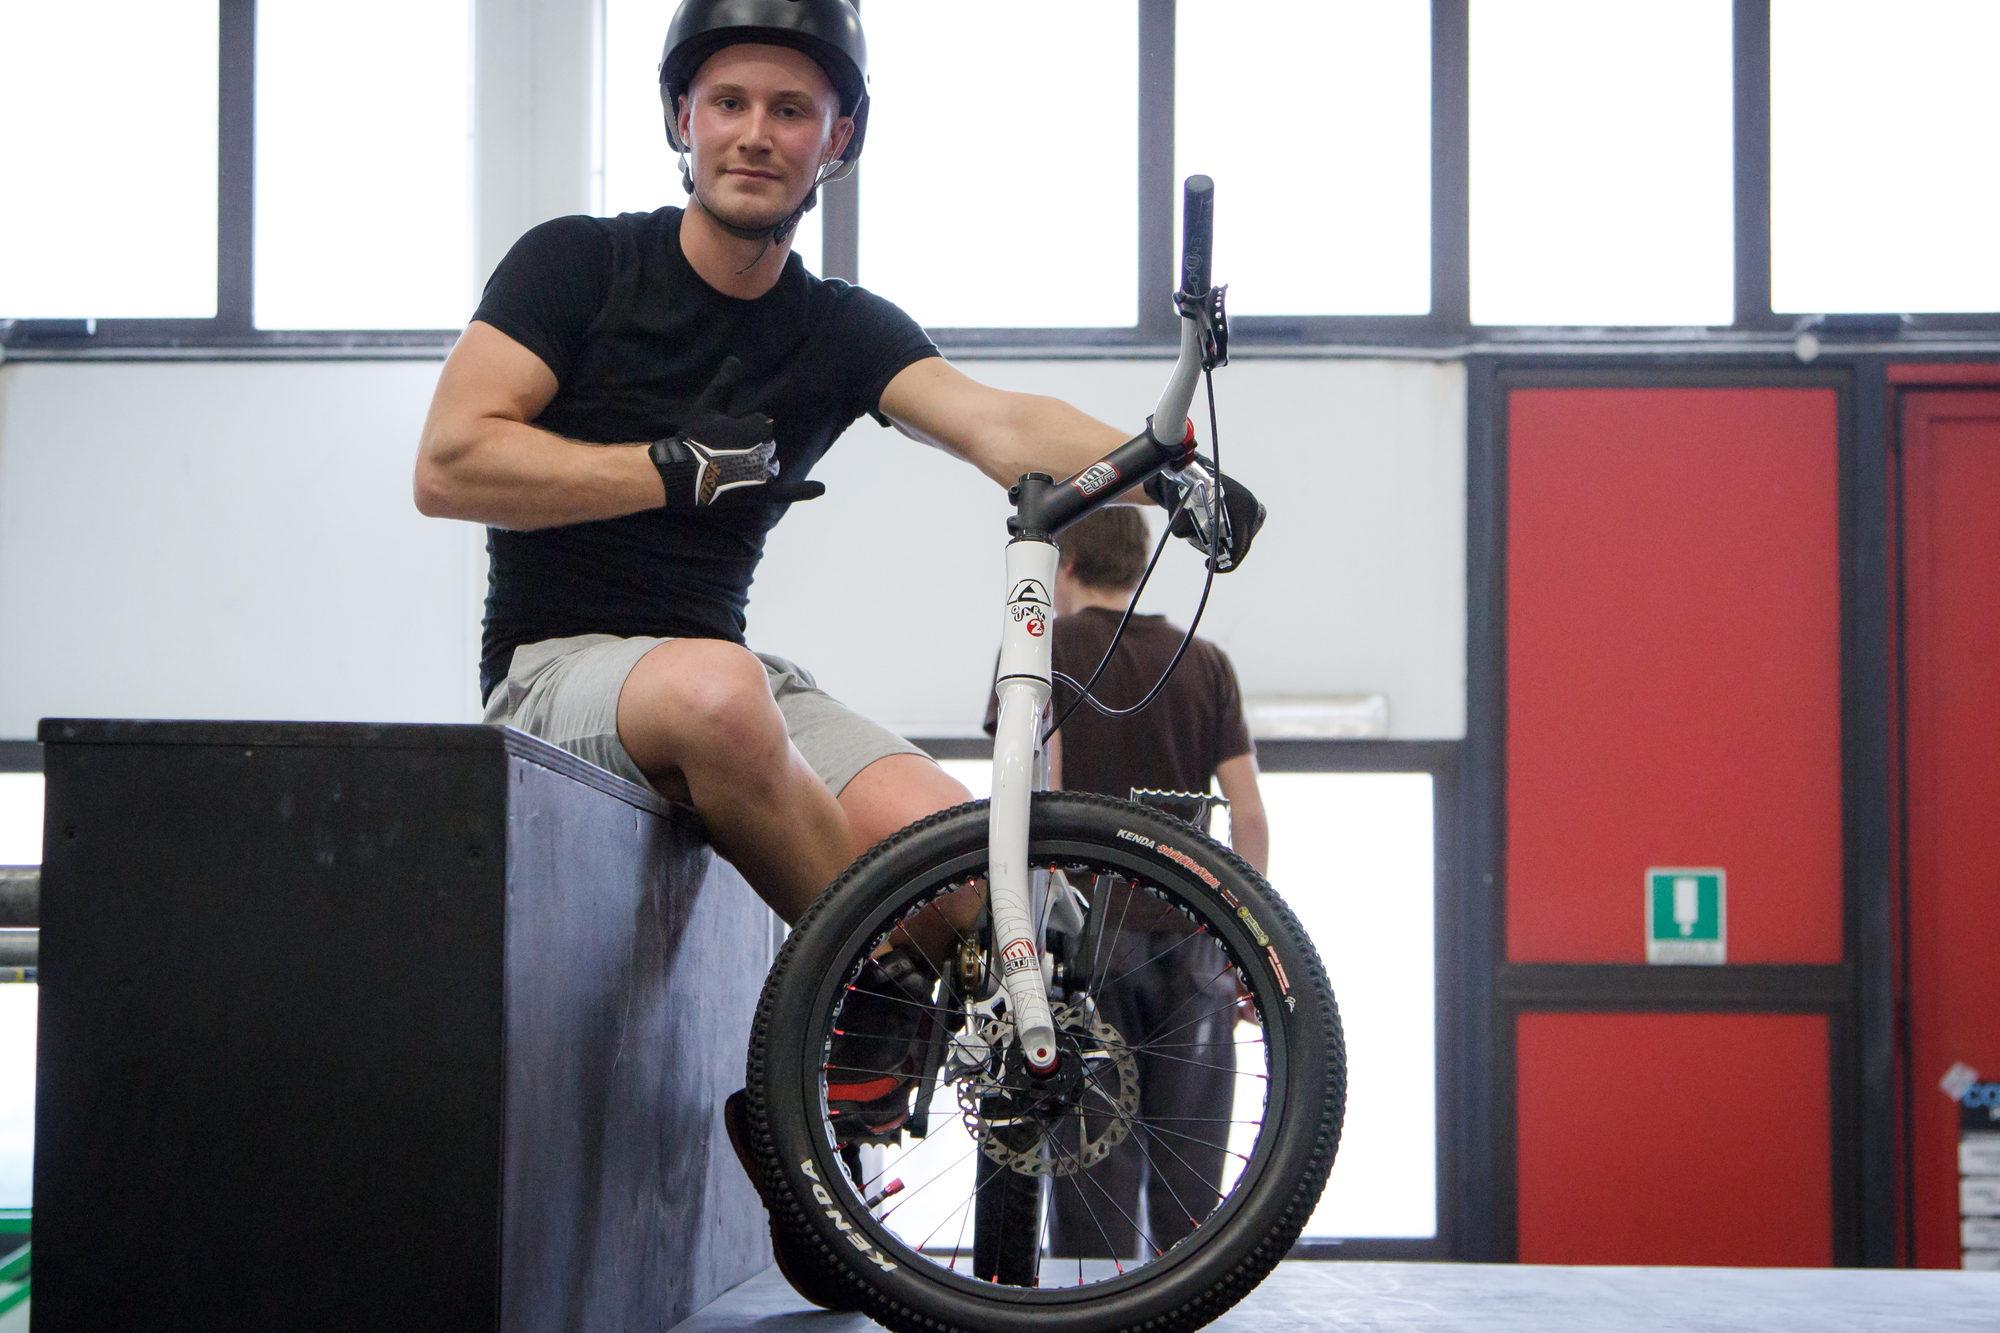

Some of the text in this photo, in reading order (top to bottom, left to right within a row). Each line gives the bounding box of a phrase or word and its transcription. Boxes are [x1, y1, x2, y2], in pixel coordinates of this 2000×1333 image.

[1029, 619, 1044, 635] 2
[1116, 829, 1156, 849] KENDA
[801, 1159, 898, 1272] KENDA
